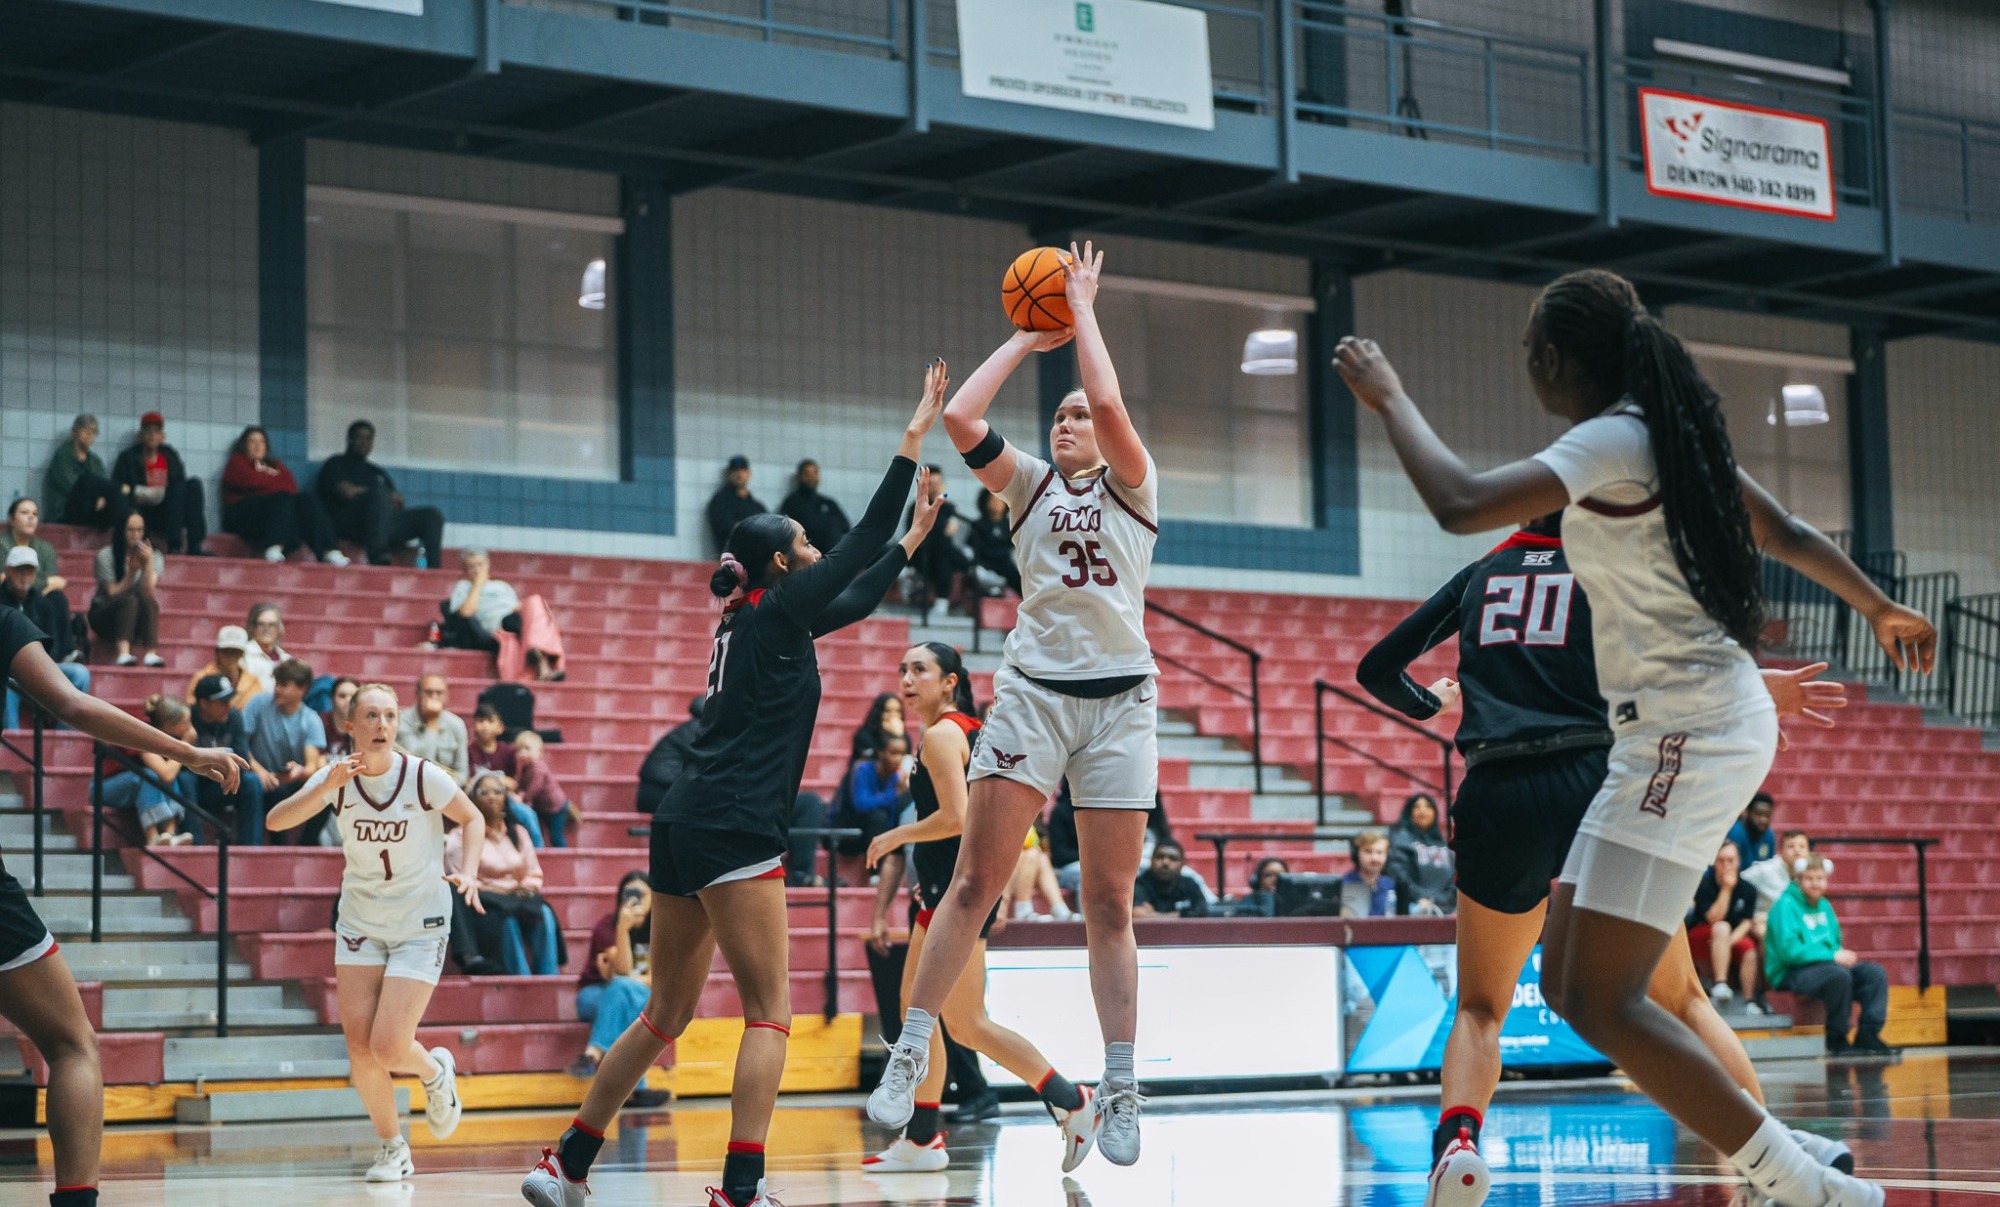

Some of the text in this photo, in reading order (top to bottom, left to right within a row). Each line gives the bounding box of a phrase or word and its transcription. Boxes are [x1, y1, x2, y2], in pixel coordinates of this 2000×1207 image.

[1701, 126, 1819, 170] Signarama
[1667, 164, 1728, 188] DENTON
[1048, 505, 1102, 533] TWU
[1058, 540, 1118, 588] 35
[1522, 552, 1556, 566] SR
[1479, 573, 1576, 647] 20
[706, 631, 732, 700] 21
[997, 760, 1015, 769] TWU
[354, 819, 408, 842] TWU
[379, 849, 392, 881] 1
